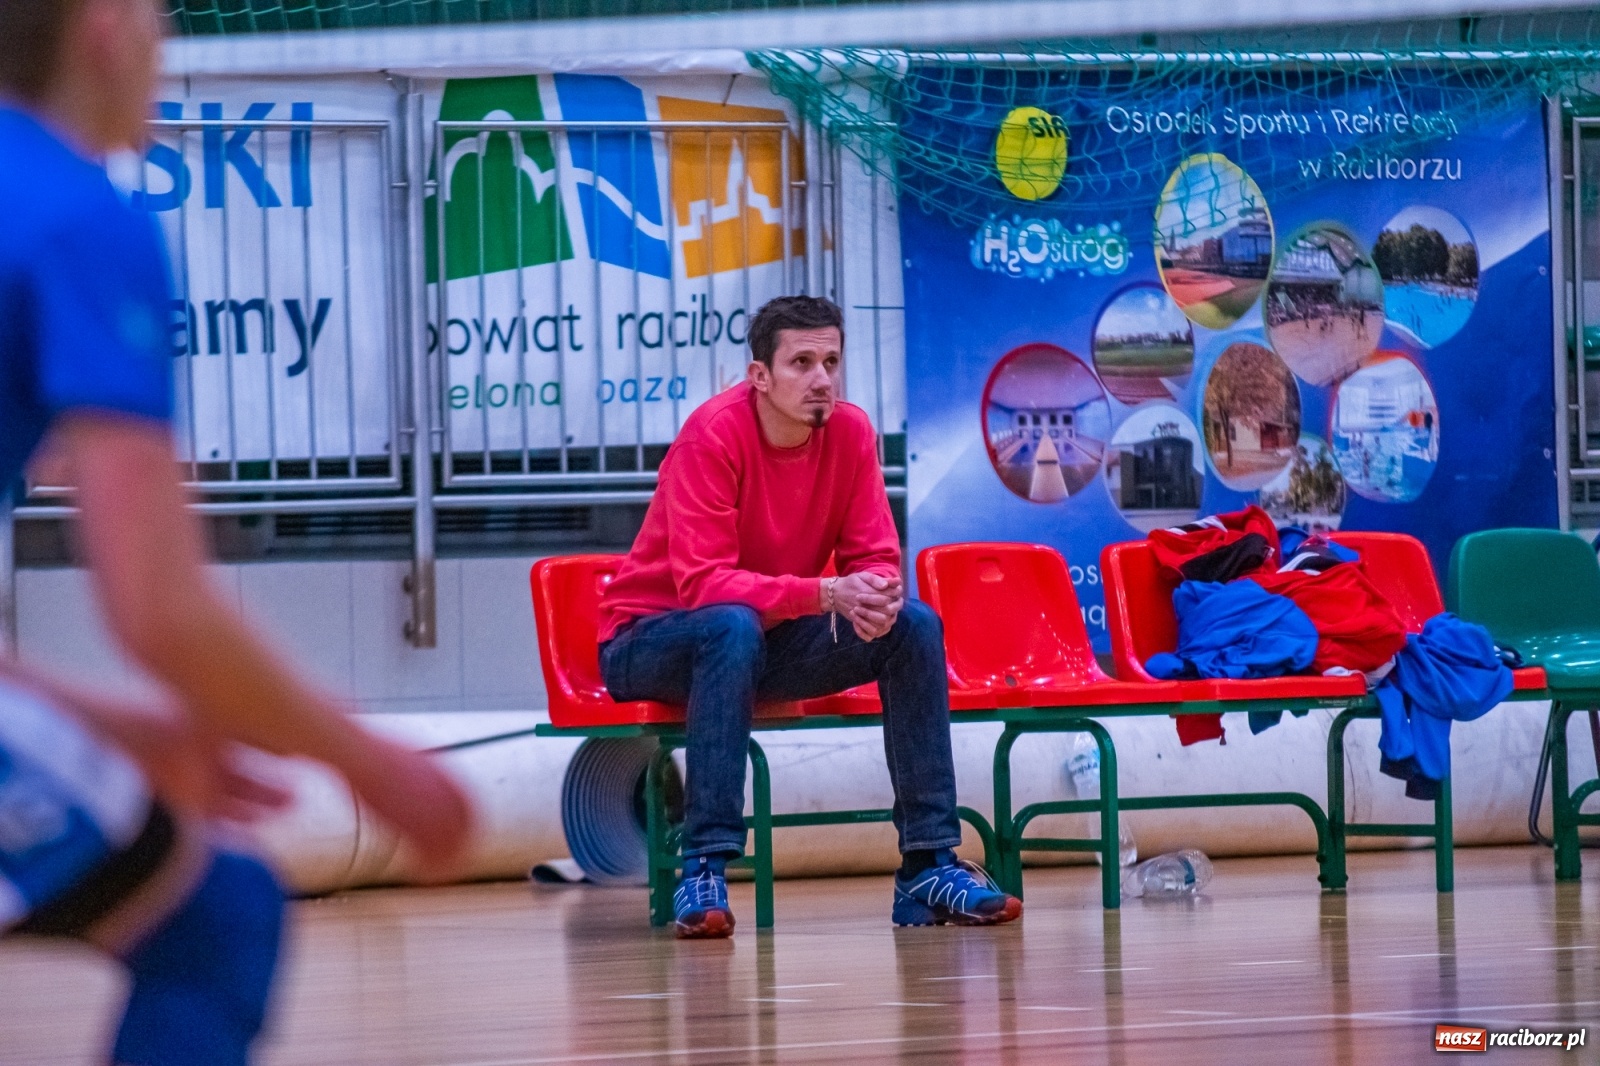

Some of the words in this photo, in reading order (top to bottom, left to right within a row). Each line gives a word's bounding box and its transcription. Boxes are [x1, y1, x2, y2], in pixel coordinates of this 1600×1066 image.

[1223, 105, 1311, 140] Sportu
[1314, 109, 1328, 134] i
[1298, 158, 1322, 180] w
[1332, 151, 1462, 181] Raciborzu
